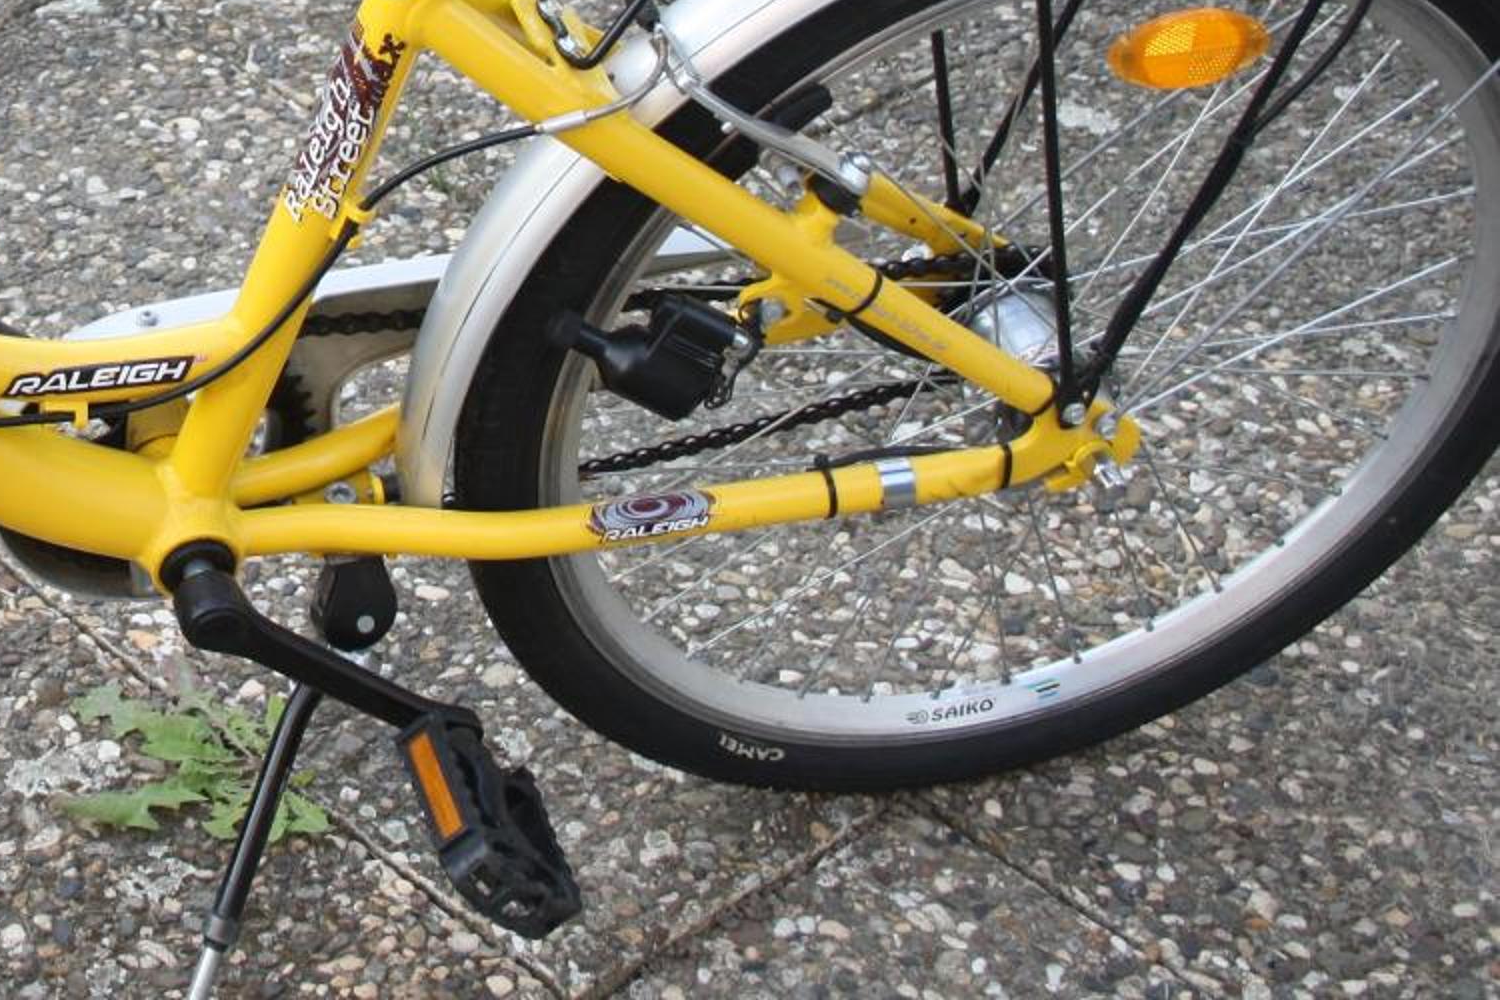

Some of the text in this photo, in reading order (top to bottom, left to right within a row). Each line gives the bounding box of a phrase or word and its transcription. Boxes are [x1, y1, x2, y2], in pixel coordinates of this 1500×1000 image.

[285, 77, 352, 222] Raleigh
[9, 360, 187, 396] RALEIGH
[604, 516, 709, 542] RALEIGH
[932, 699, 993, 721] SAIKO
